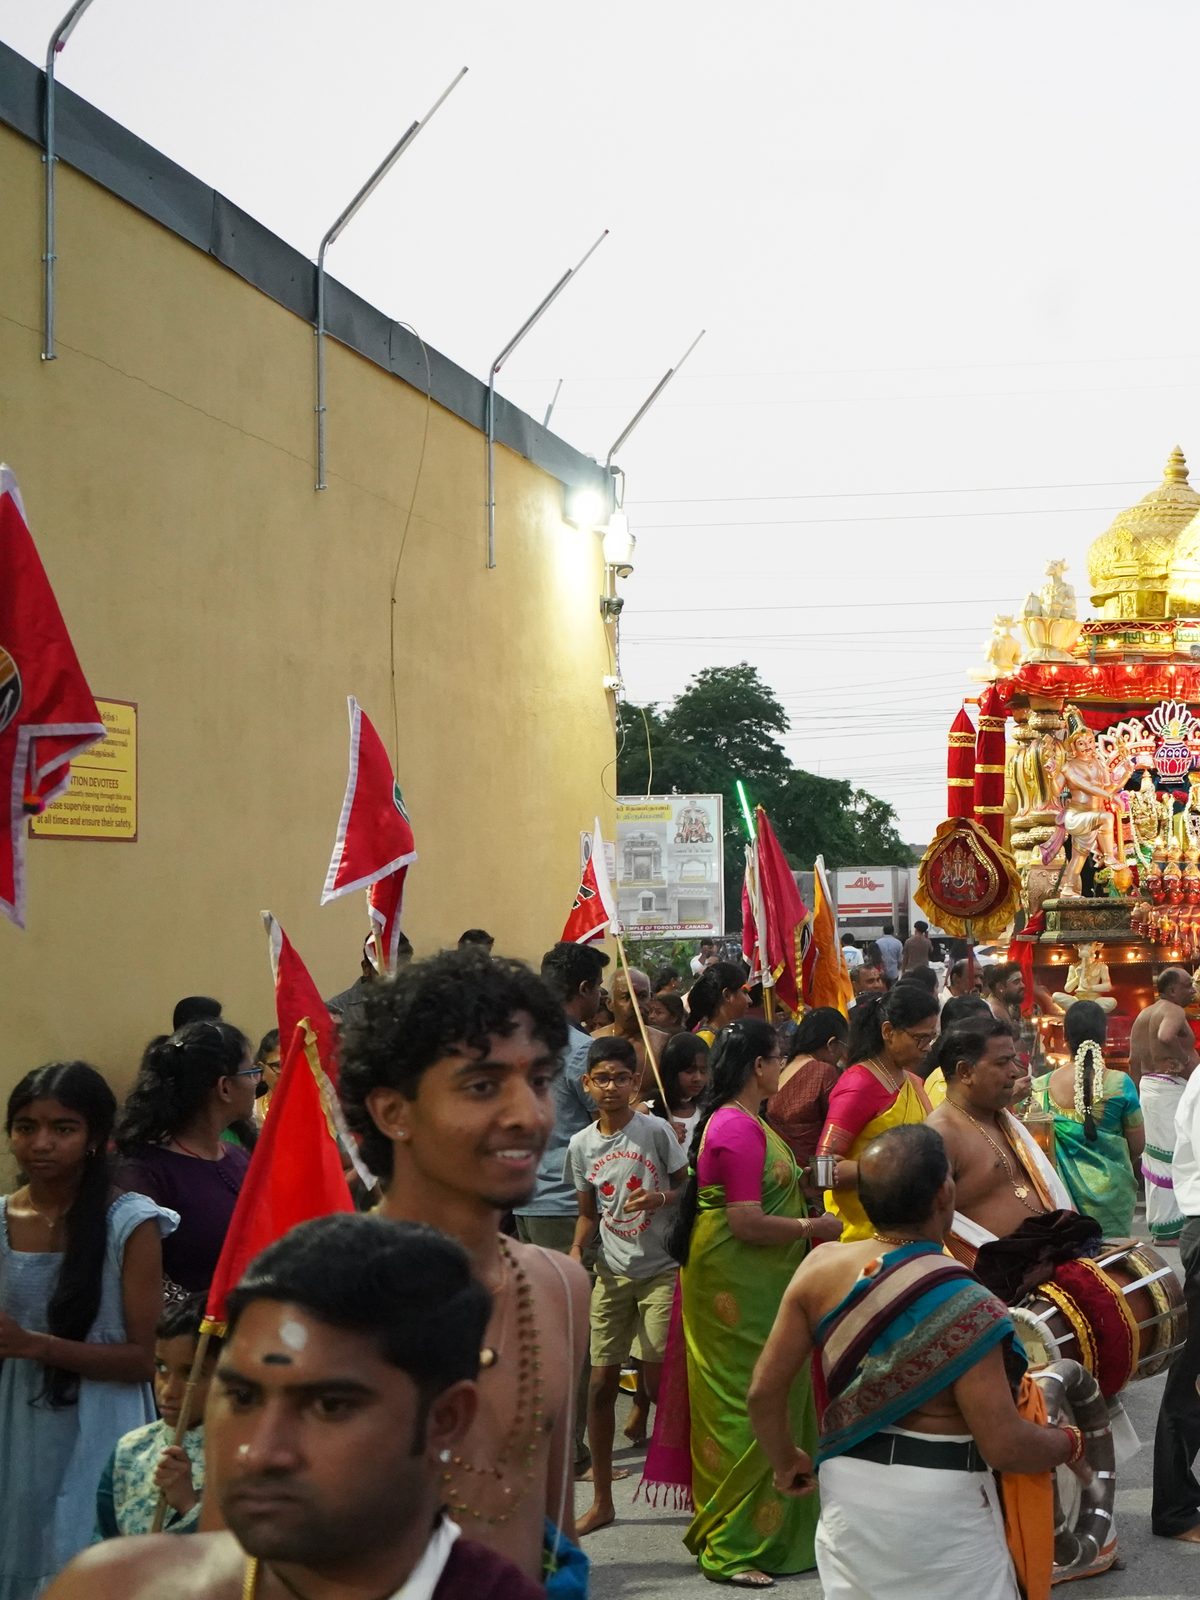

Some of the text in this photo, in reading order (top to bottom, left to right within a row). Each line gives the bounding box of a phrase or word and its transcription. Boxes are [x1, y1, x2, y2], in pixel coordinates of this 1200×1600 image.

[89, 777, 119, 789] DEVOTEES
[64, 801, 91, 812] supervise
[92, 804, 104, 813] your
[105, 803, 127, 813] children
[37, 816, 43, 824] at
[53, 814, 69, 825] times
[70, 816, 81, 826] and
[81, 818, 100, 827] ensure
[101, 817, 114, 827] their
[595, 1159, 605, 1171] OH
[605, 1151, 643, 1162] CANADA
[644, 1160, 656, 1173] OH
